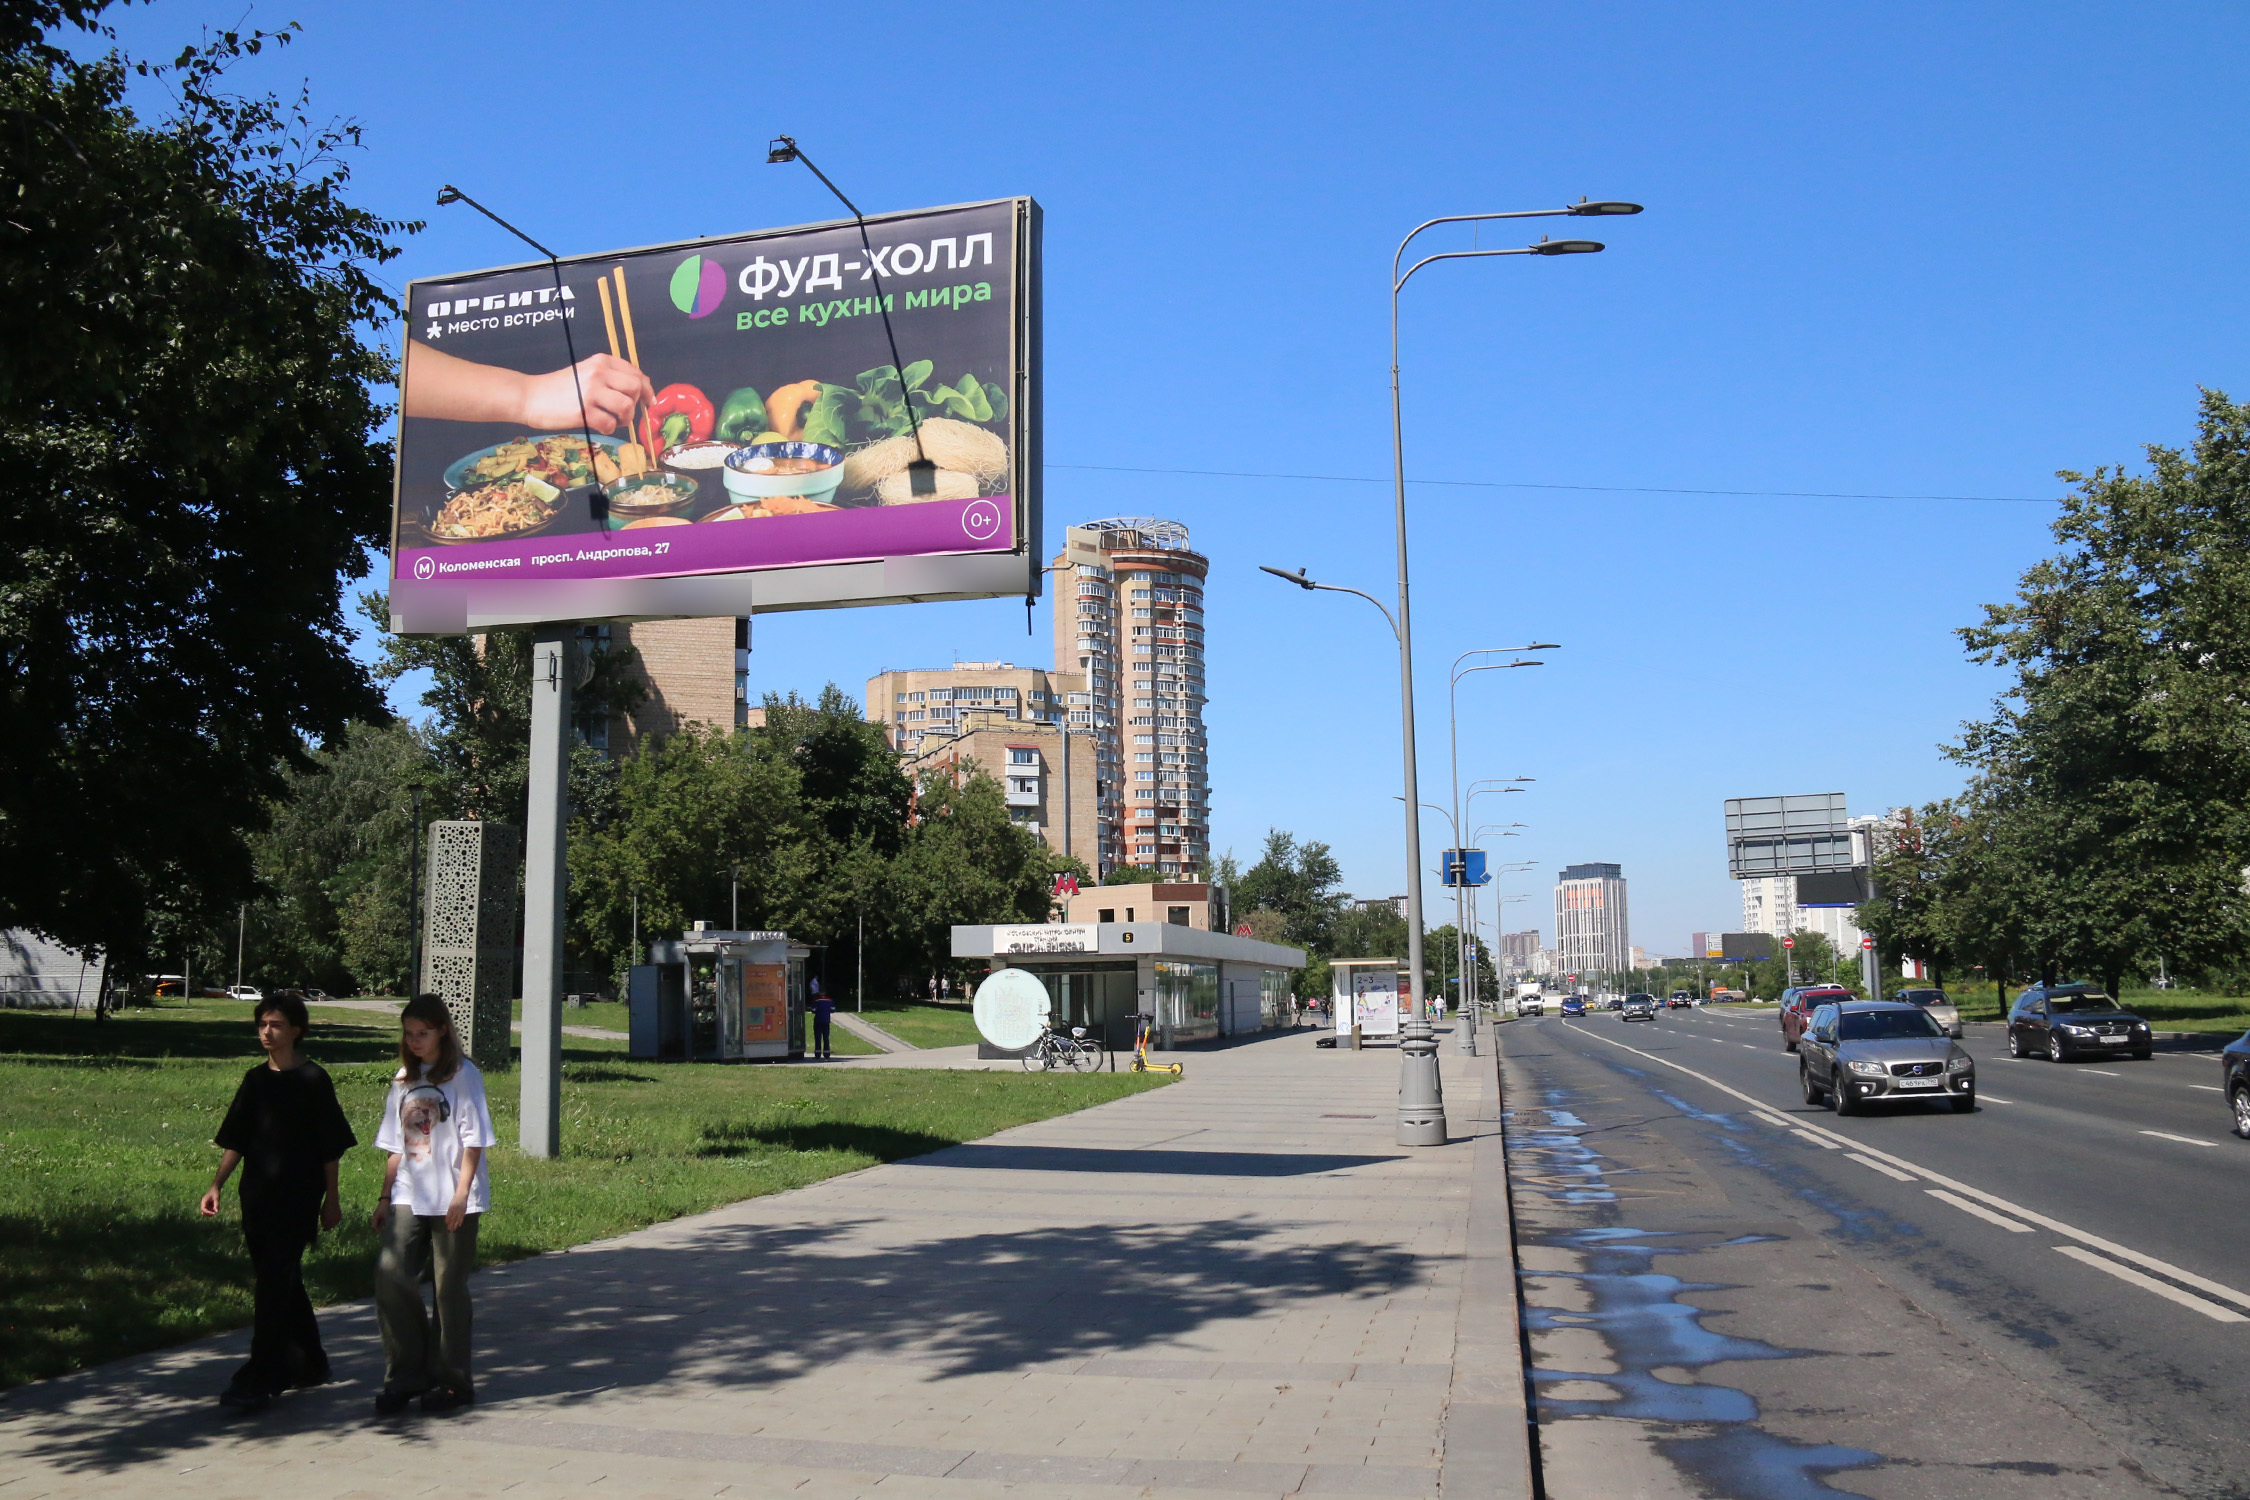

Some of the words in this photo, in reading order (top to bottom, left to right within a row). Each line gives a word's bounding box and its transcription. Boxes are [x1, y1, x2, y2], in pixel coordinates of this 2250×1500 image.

[427, 285, 576, 318] ОРБИТА
[736, 306, 790, 331] все
[799, 293, 894, 327] кухни
[905, 281, 992, 311] мира
[447, 316, 500, 335] место
[503, 306, 576, 328] встречи
[970, 512, 992, 528] 0+
[438, 556, 521, 573] Коломенская
[531, 552, 574, 566] просп.
[575, 544, 653, 562] Андропова,
[654, 542, 671, 555] 27
